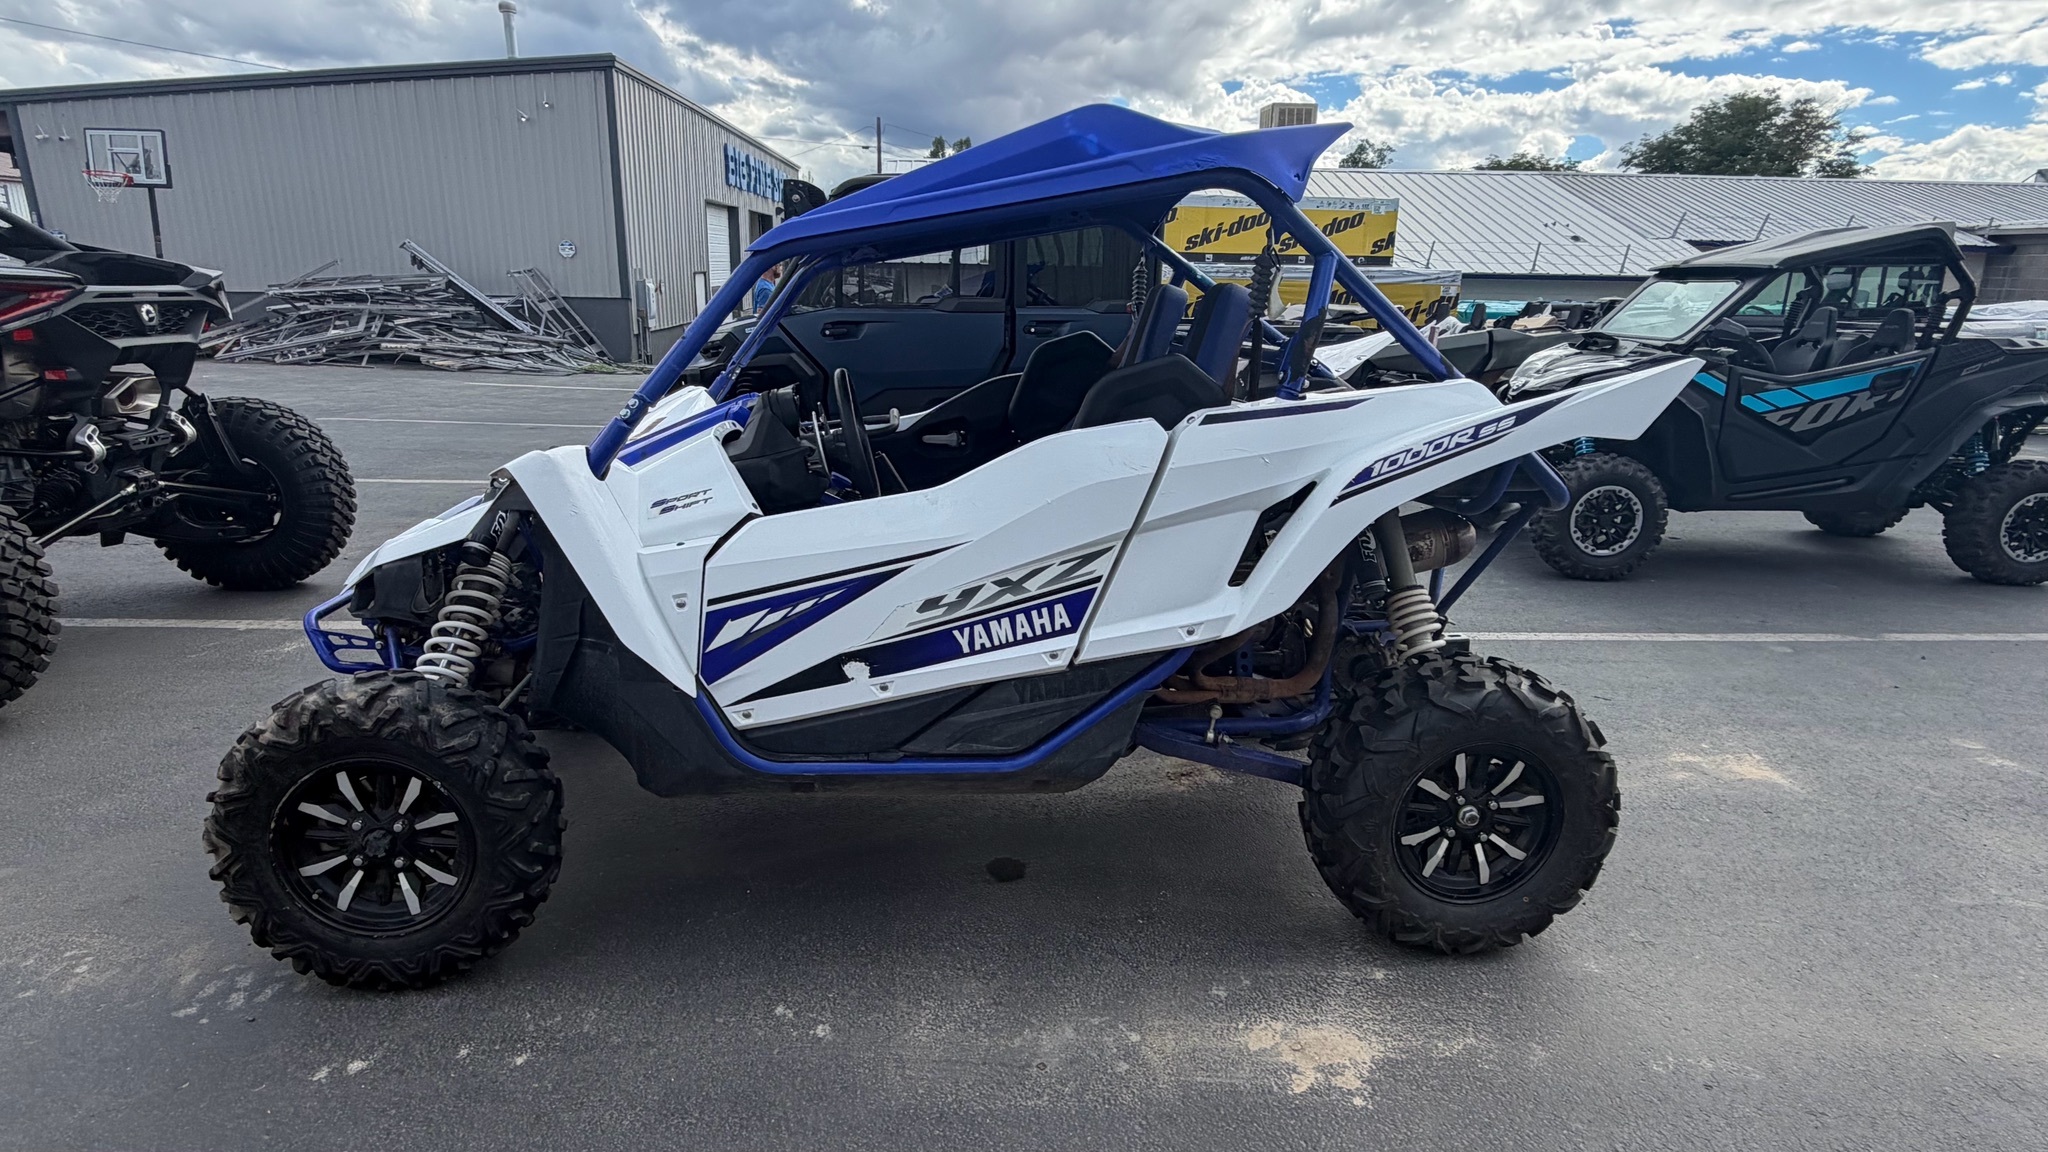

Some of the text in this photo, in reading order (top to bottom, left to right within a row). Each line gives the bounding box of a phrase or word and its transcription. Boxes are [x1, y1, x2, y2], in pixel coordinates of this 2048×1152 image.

[724, 143, 747, 191] BIG
[747, 154, 774, 199] PINE
[1184, 211, 1270, 251] ski-doo
[1370, 415, 1517, 478] 1000R SS
[650, 488, 713, 509] SPORT
[659, 497, 714, 515] SHIFT
[952, 602, 1072, 654] YAMAHA
